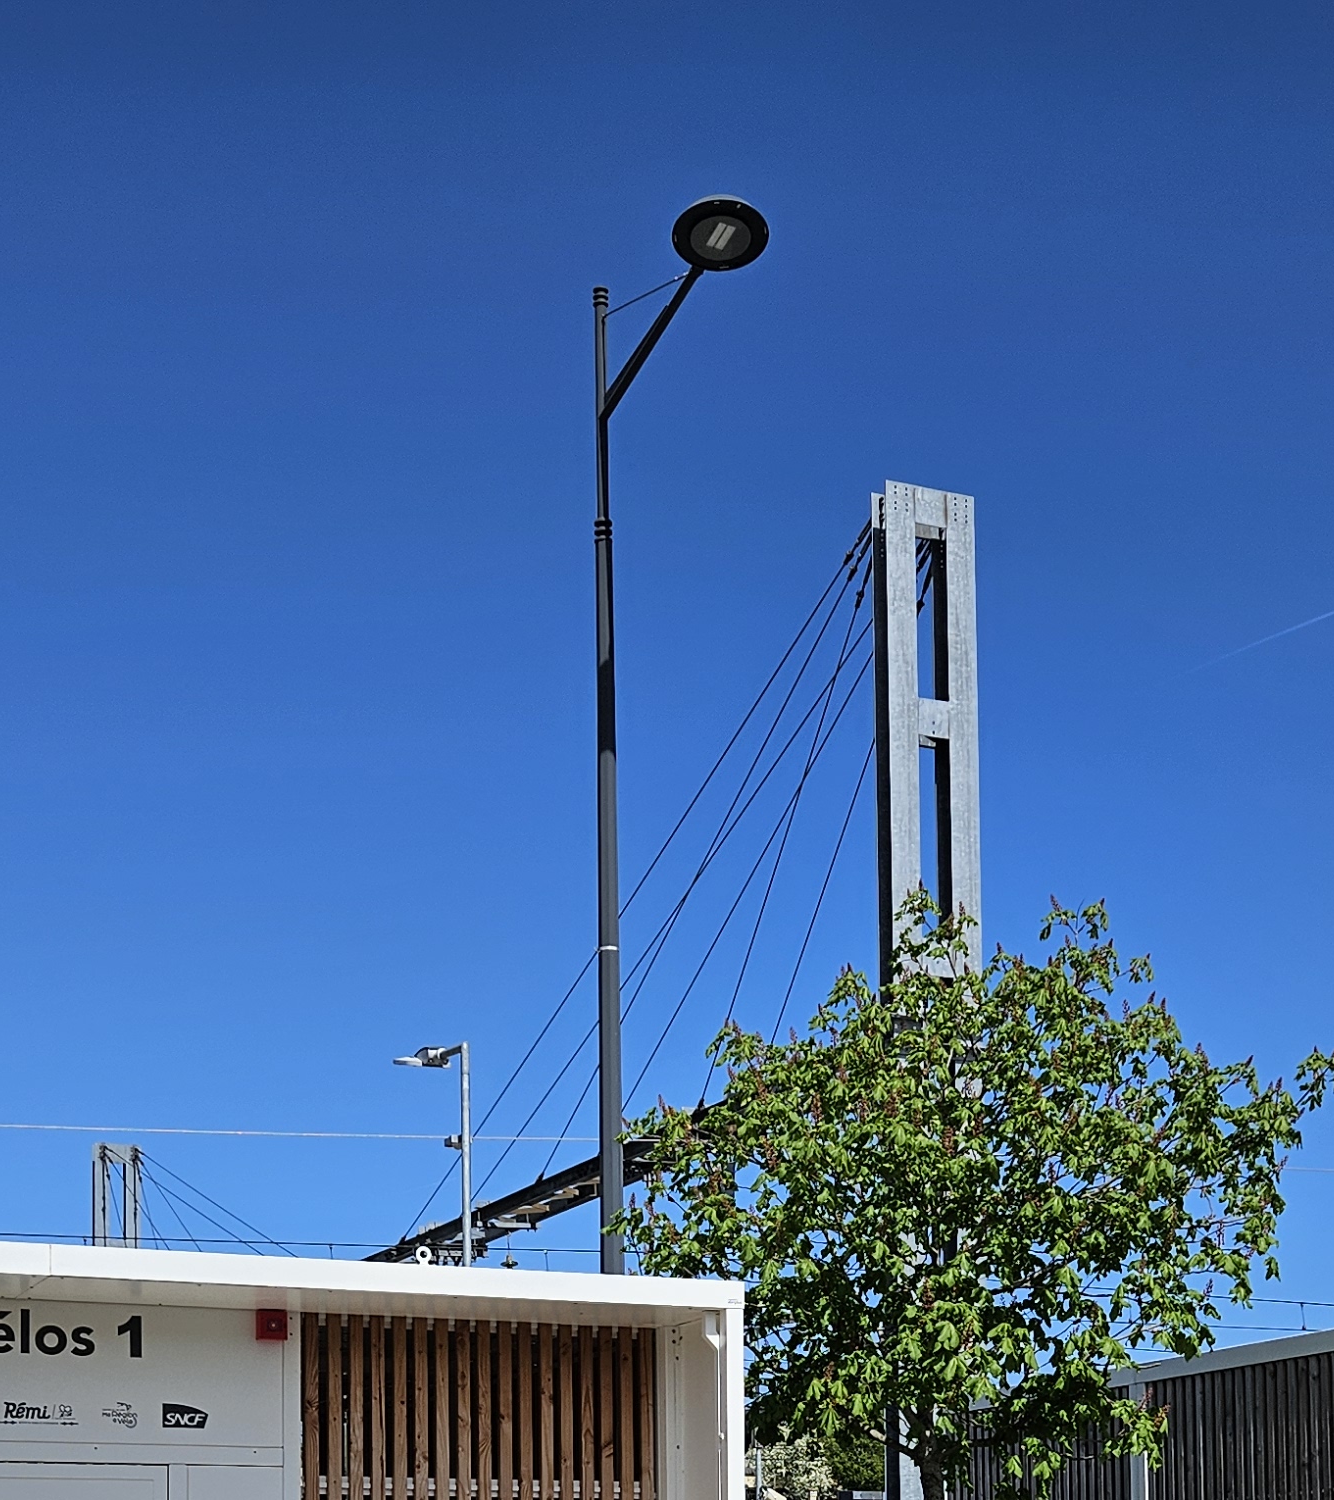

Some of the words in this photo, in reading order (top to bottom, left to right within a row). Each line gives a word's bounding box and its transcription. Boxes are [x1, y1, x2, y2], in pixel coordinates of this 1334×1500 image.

[118, 1315, 143, 1358] 1
[4, 1402, 51, 1420] Rémi
[164, 1413, 206, 1426] SNCF
